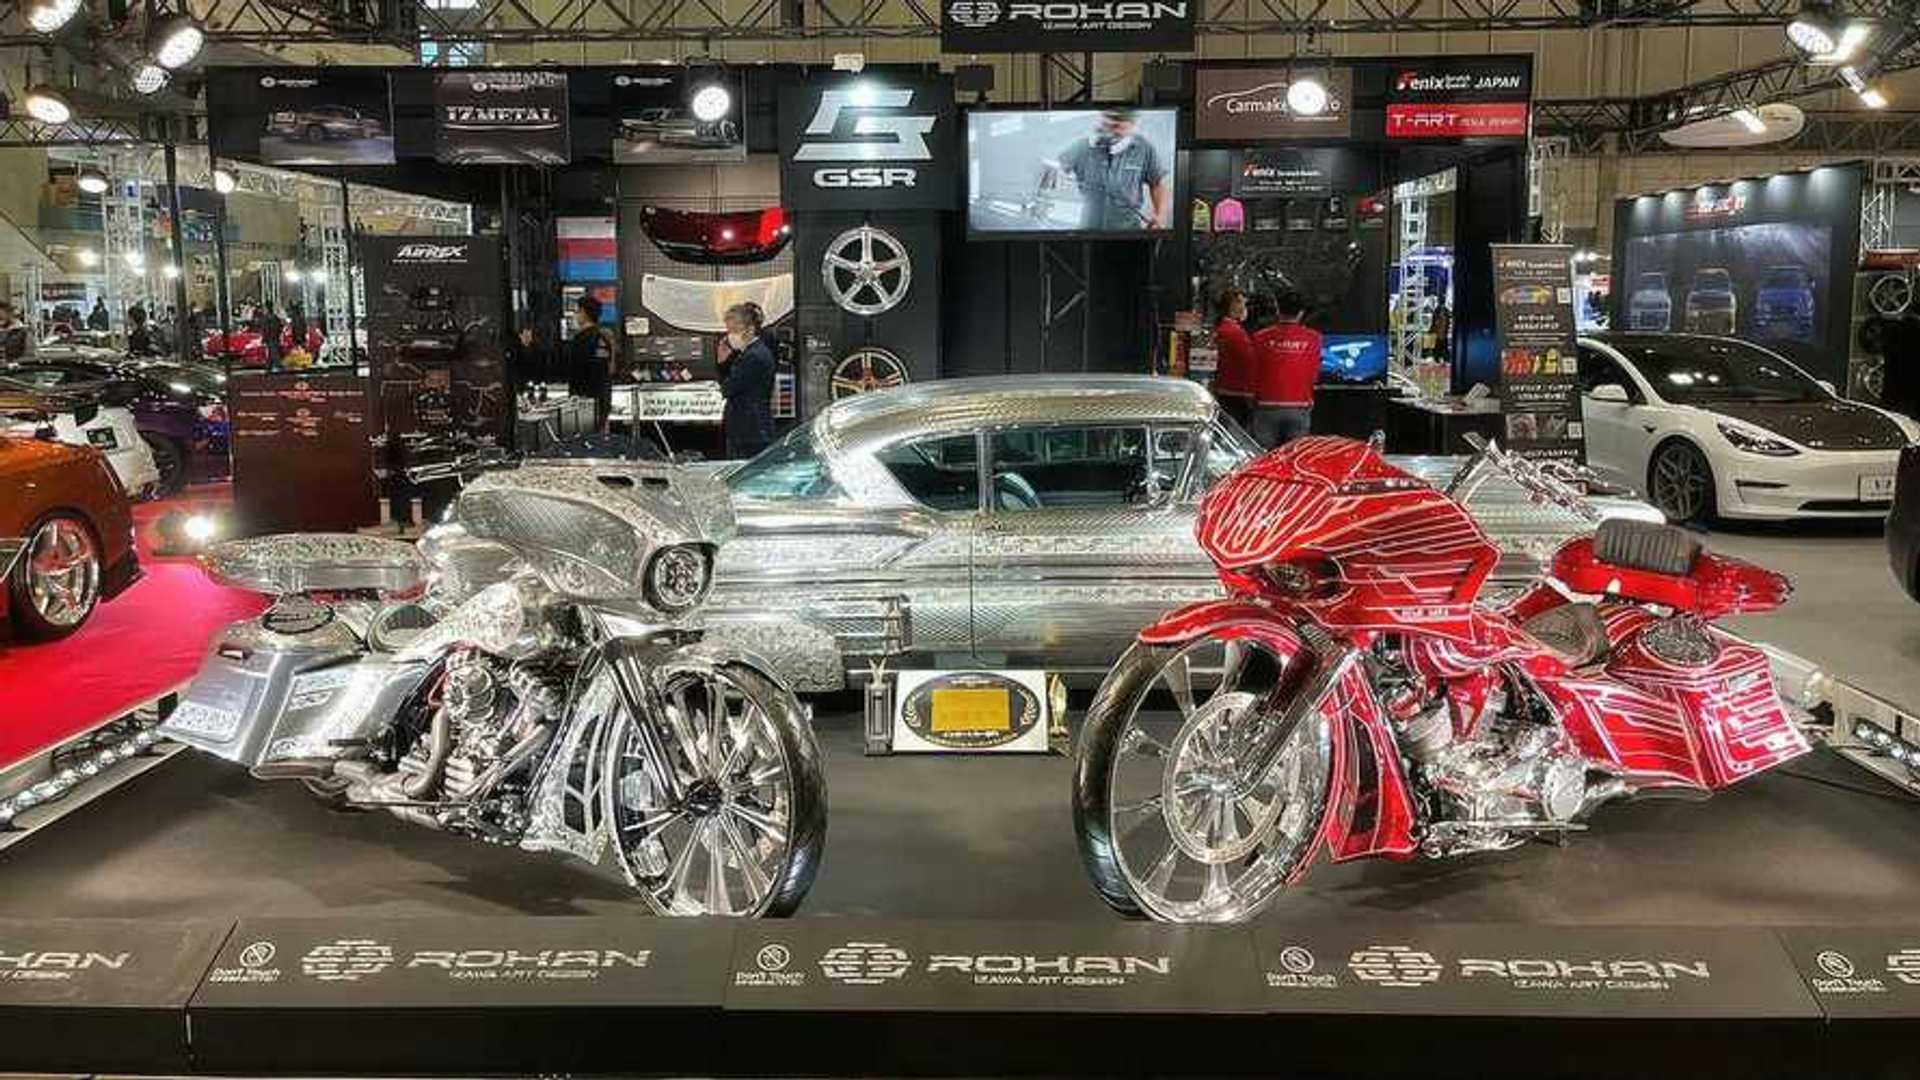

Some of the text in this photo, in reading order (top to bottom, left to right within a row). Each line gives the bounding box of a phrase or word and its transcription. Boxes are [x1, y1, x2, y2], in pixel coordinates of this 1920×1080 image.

[1008, 1, 1187, 20] ROHAN
[1474, 76, 1520, 89] JAPAN
[1392, 114, 1458, 127] T-ART
[813, 168, 917, 188] GSR
[407, 950, 651, 968] ROHAN
[926, 954, 1170, 974] ROHAN
[1458, 958, 1710, 979] ROHAN
[974, 974, 1024, 985] IZAWA
[1027, 975, 1062, 985] ART
